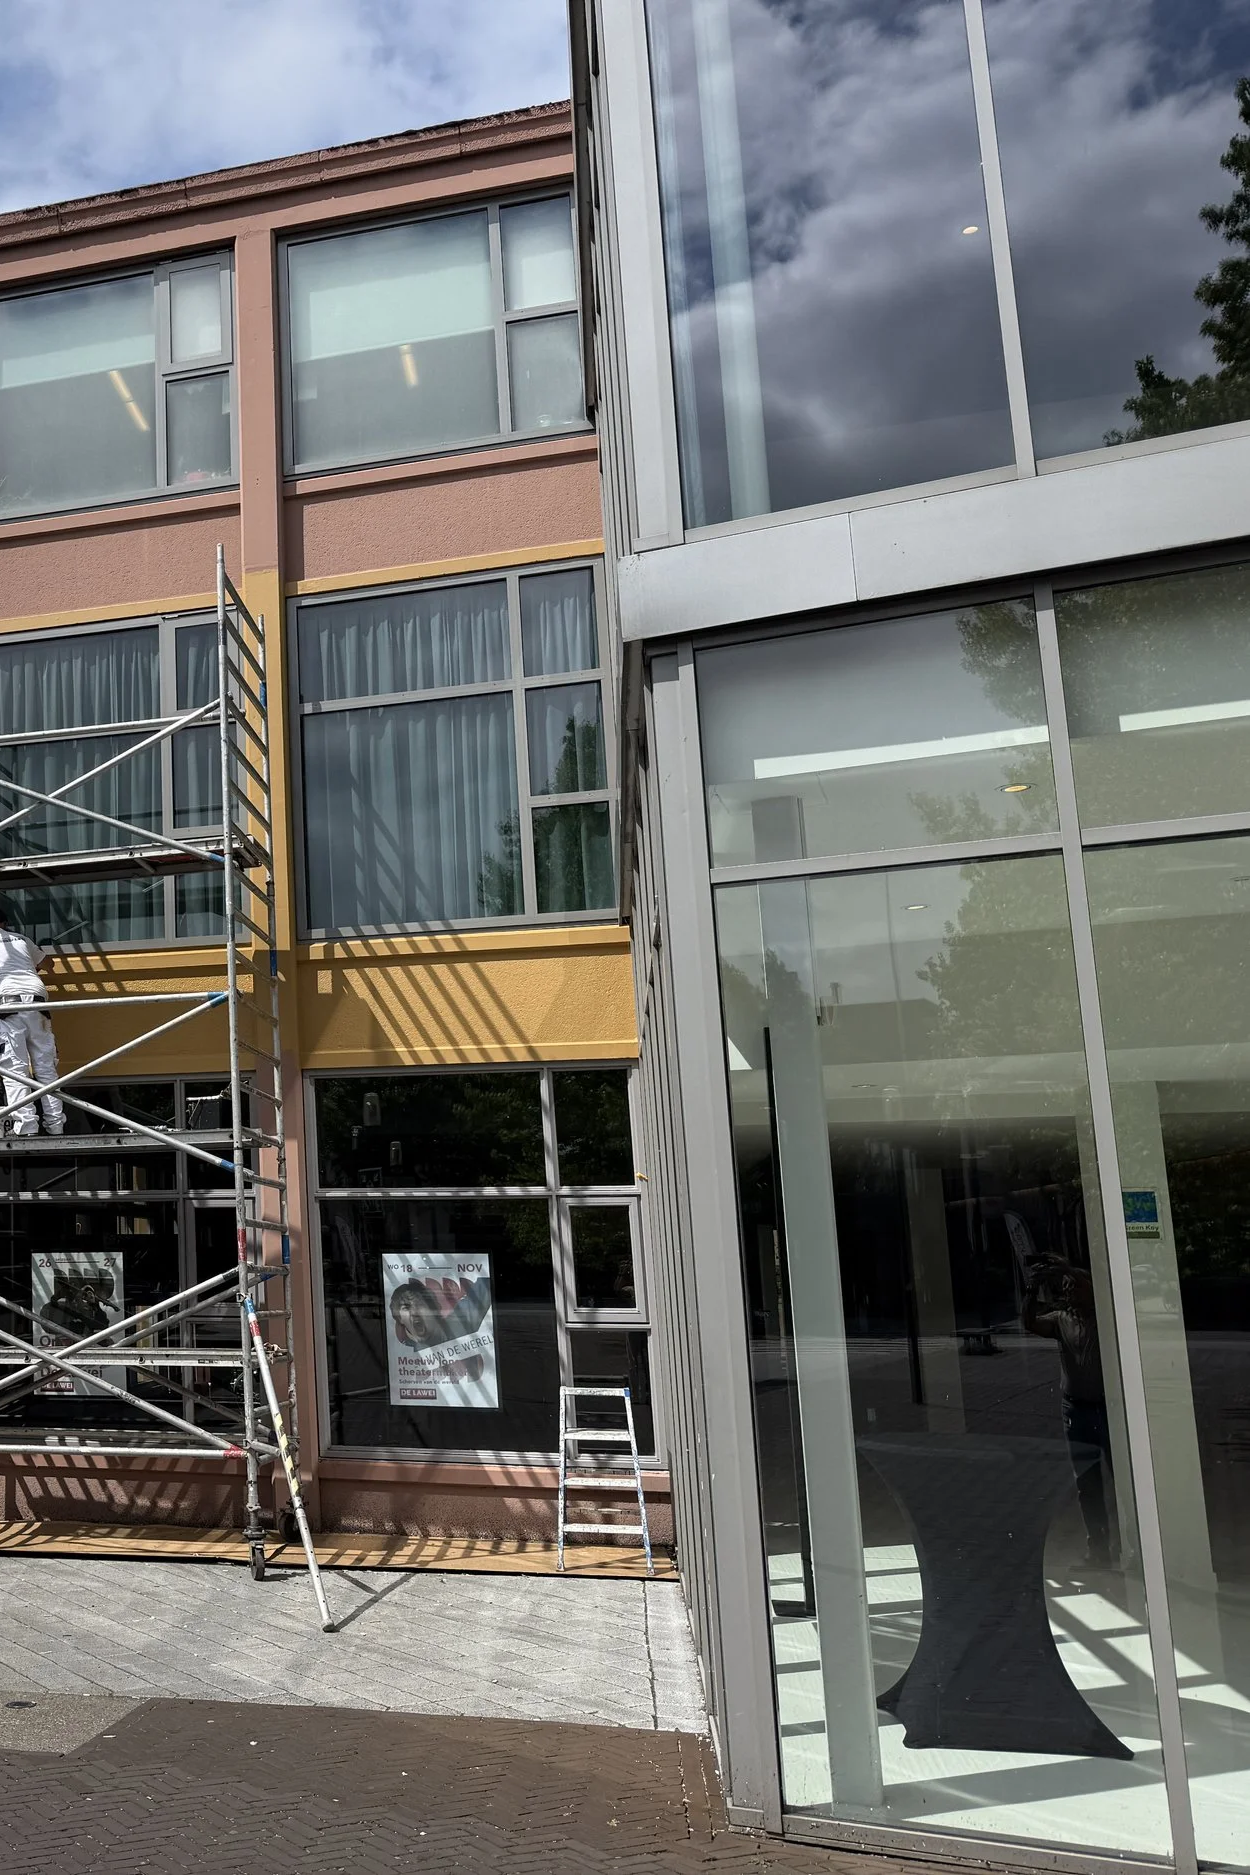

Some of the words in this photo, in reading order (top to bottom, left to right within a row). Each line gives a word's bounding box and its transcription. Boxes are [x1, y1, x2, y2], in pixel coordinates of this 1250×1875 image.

[38, 1258, 52, 1268] 26
[103, 1257, 117, 1267] 27
[400, 1264, 413, 1273] 18
[457, 1263, 483, 1273] NOV
[446, 1345, 461, 1357] DE
[461, 1335, 494, 1352] WEREL
